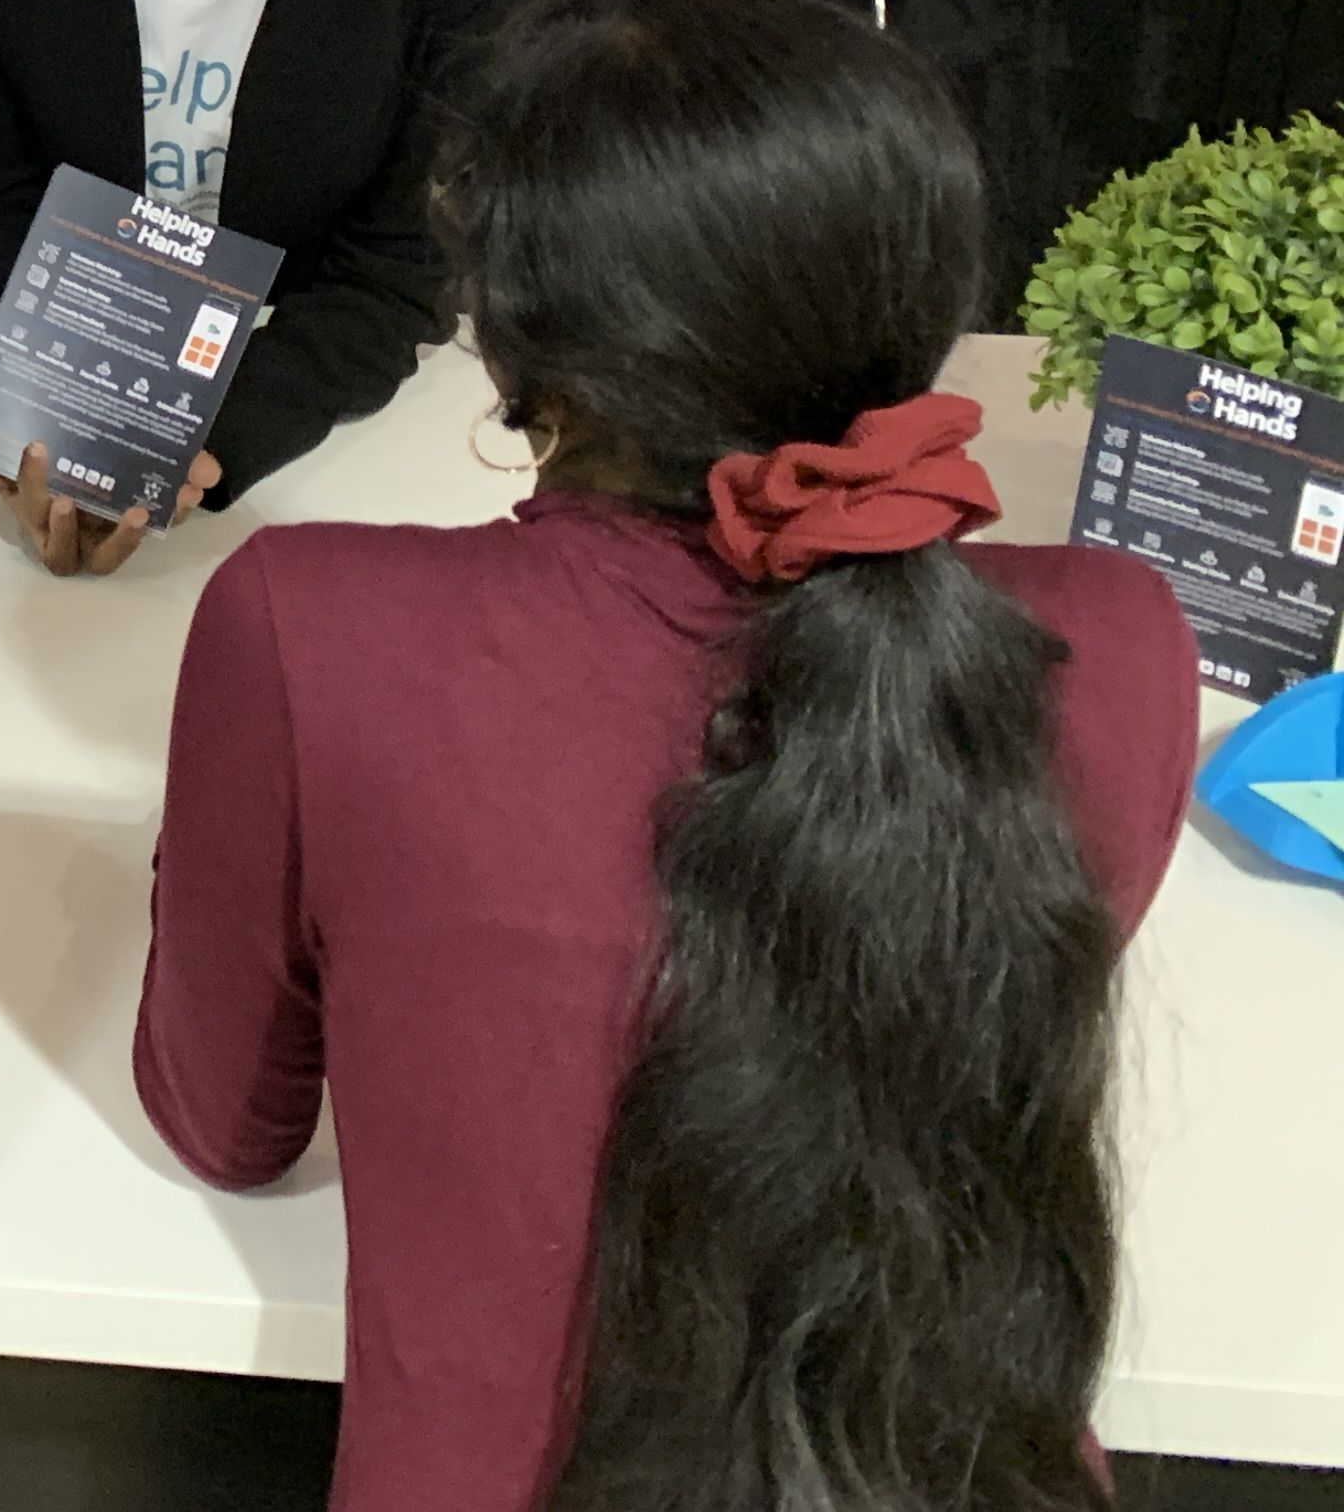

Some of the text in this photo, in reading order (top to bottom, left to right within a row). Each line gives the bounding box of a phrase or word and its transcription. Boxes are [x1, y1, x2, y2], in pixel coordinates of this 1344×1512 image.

[130, 194, 216, 248] Helping
[136, 224, 207, 267] Hands
[1198, 362, 1303, 418] Helping
[1213, 395, 1298, 442] Hands
